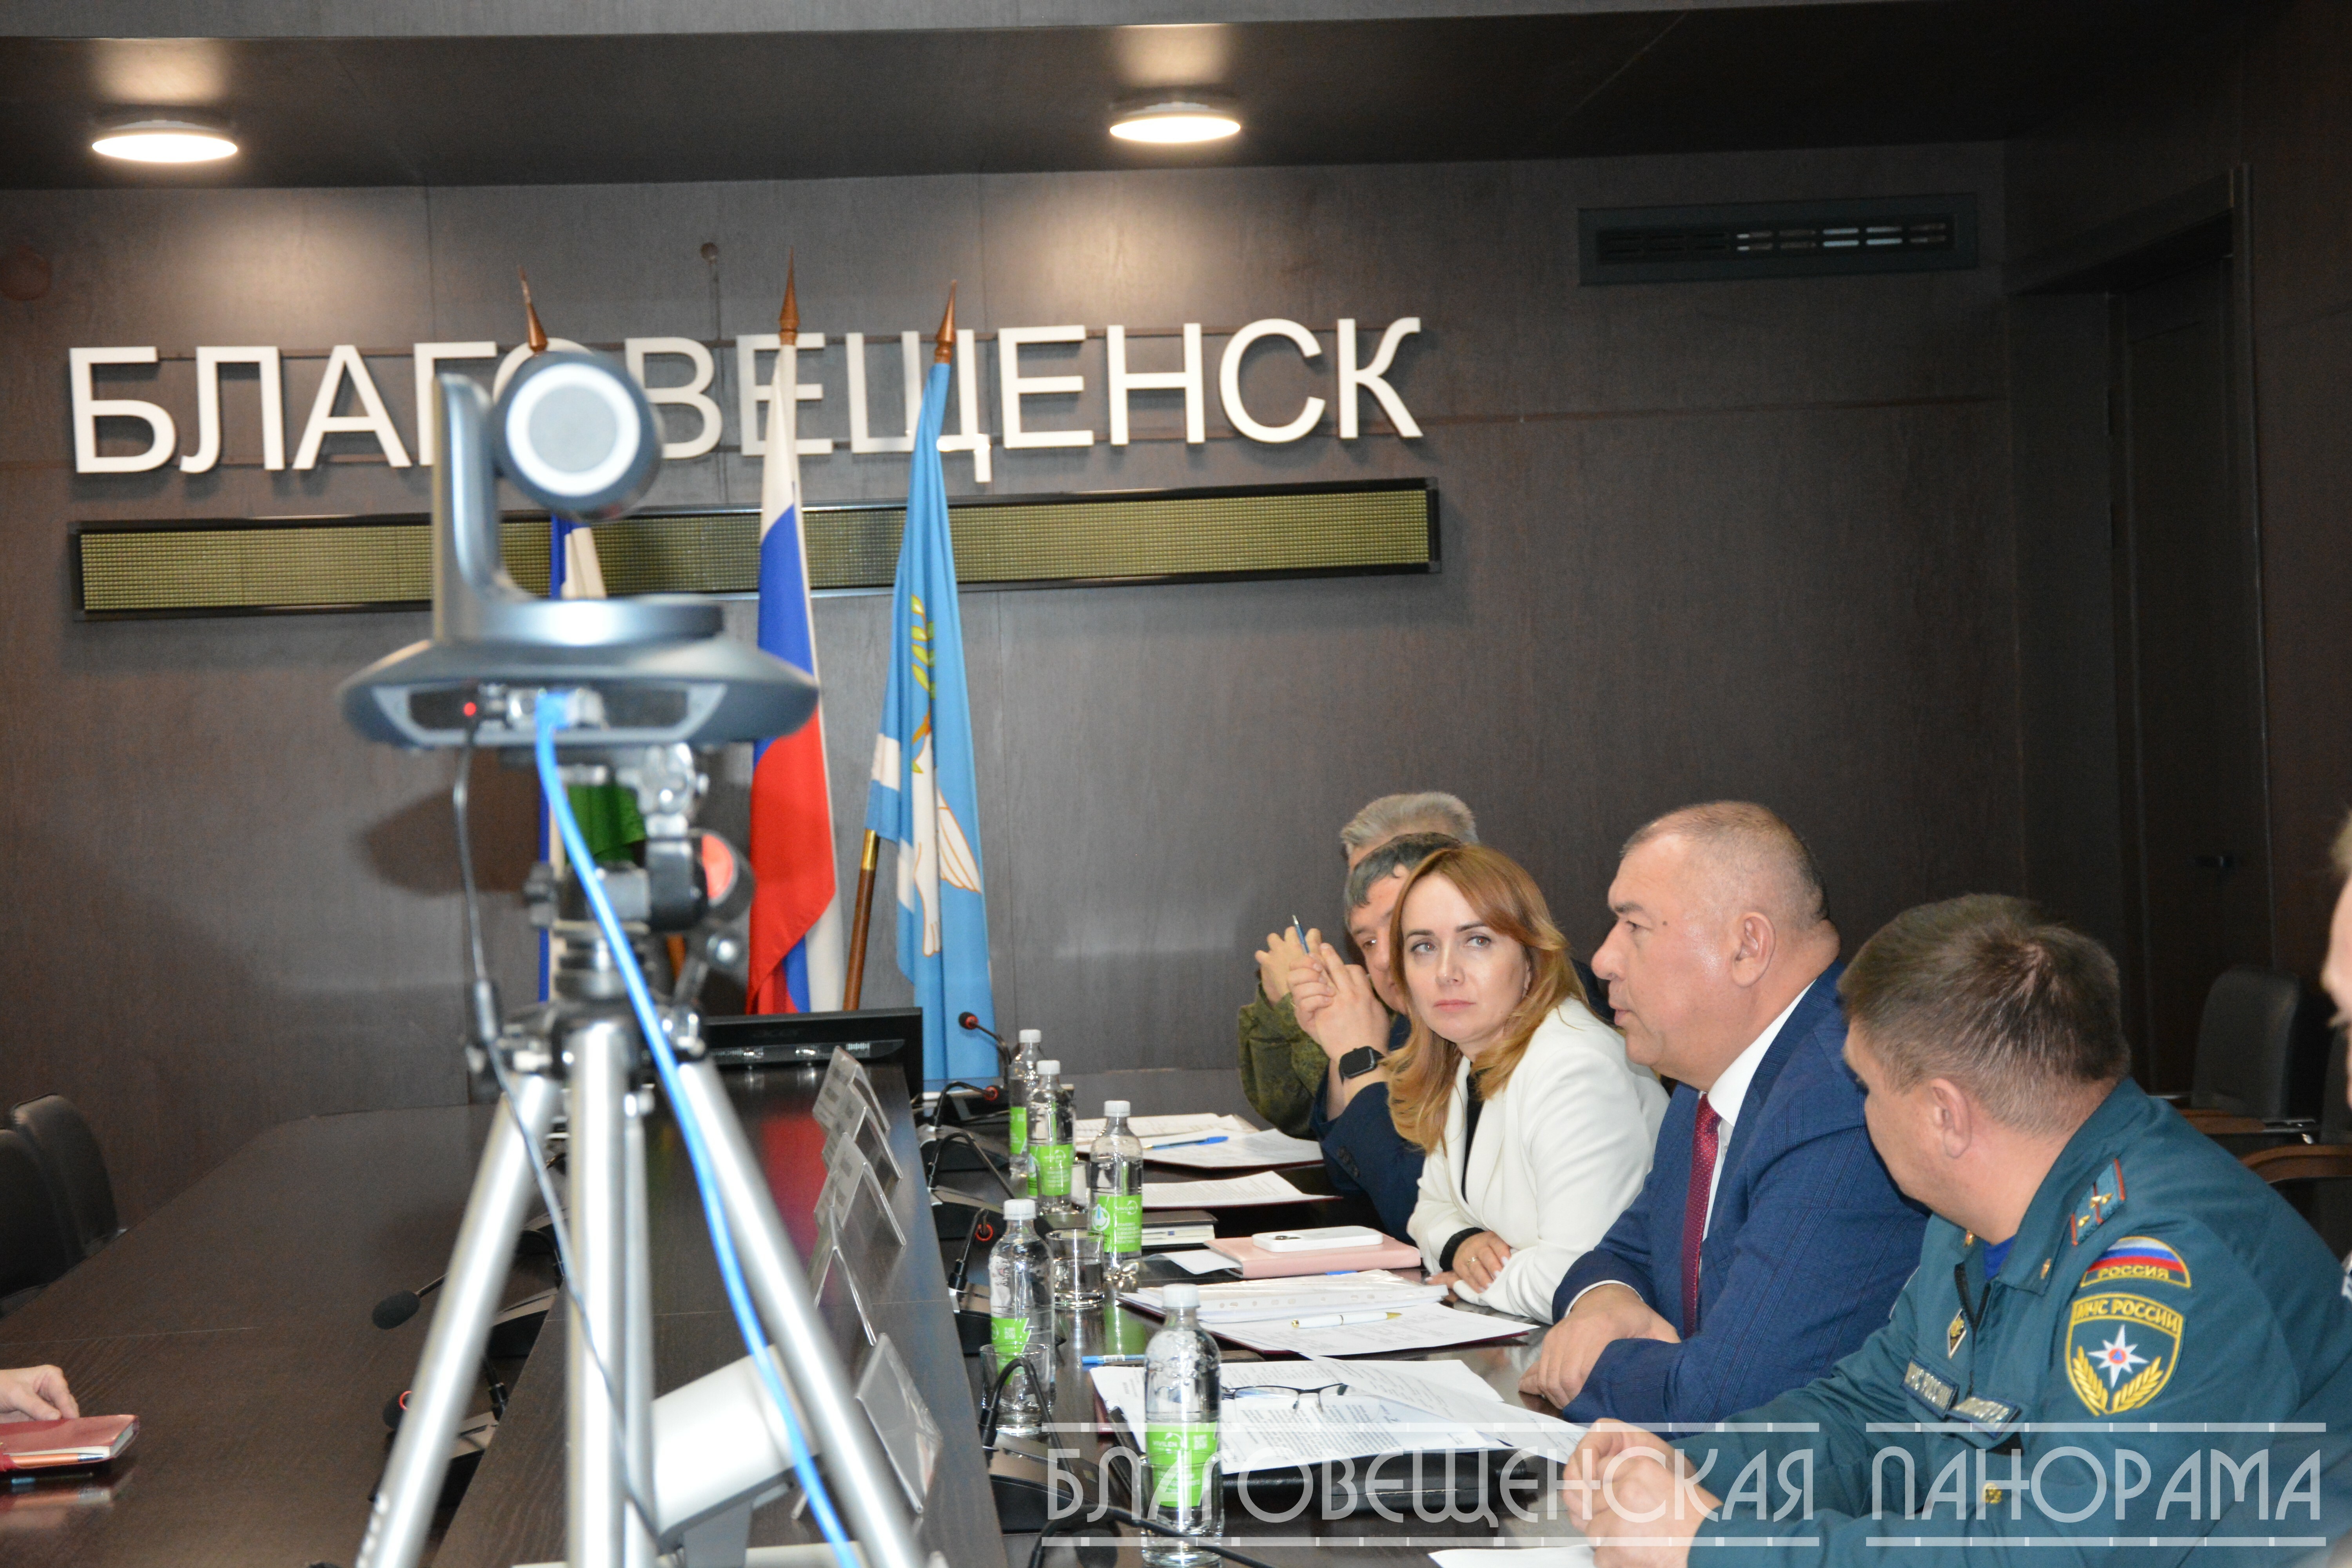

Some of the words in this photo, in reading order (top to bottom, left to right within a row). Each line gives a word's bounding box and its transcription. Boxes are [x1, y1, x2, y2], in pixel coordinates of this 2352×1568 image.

[2098, 1265, 2169, 1279] РОССИЯ
[2077, 1299, 2109, 1319] МЧС
[2111, 1298, 2179, 1332] РОССИИ
